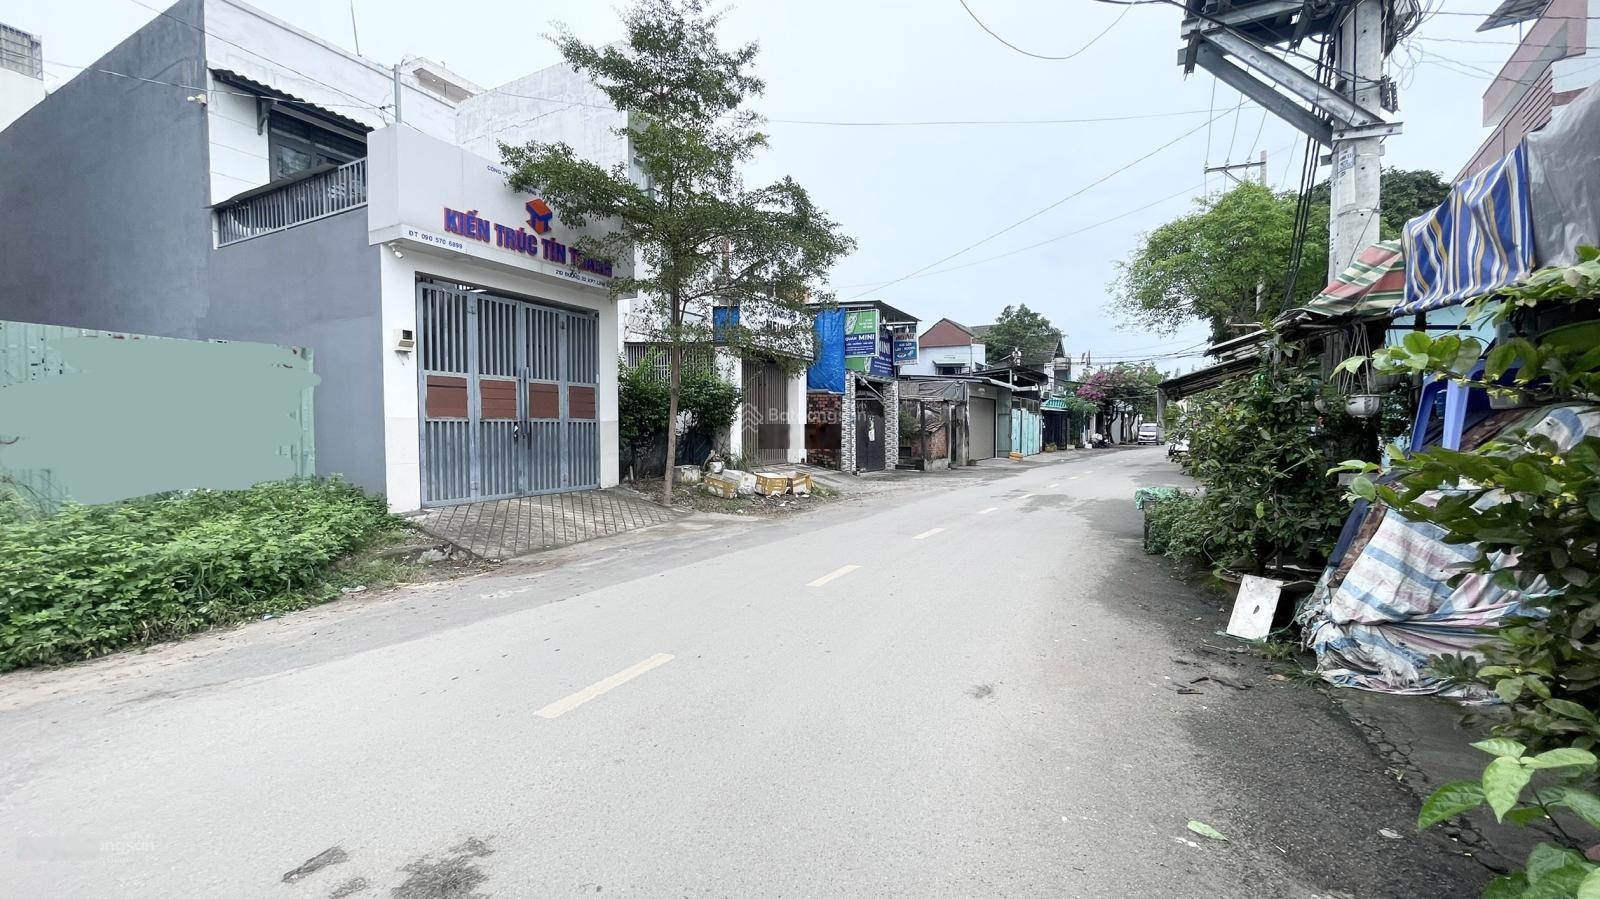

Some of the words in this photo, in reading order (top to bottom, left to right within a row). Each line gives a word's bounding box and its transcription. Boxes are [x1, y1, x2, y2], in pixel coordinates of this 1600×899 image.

[421, 233, 433, 242] 090
[443, 207, 490, 243] KIẾN
[494, 223, 538, 256] TRÚC
[541, 237, 566, 264] TÍN
[858, 333, 875, 341] MINI
